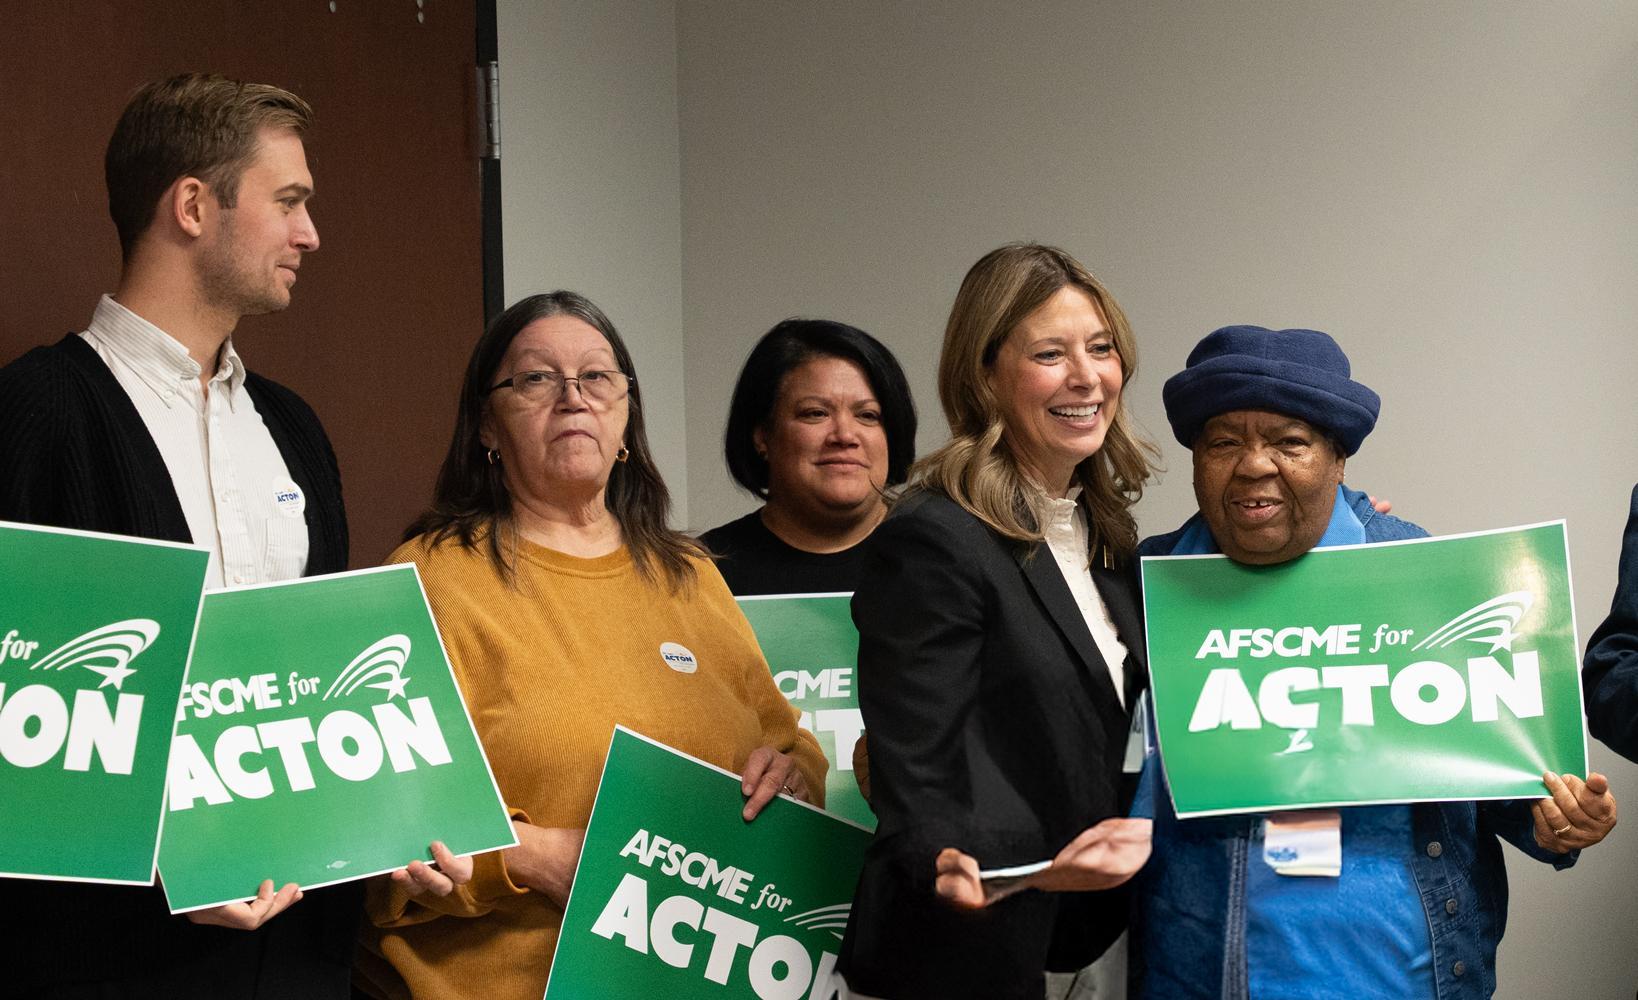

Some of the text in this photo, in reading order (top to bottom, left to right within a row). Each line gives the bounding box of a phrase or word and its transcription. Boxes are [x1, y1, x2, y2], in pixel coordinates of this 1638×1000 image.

[277, 491, 299, 503] ACTON
[0, 629, 39, 665] for
[665, 654, 693, 663] ACTON
[1194, 623, 1414, 660] AFSCME for
[176, 671, 321, 722] FSCME for
[773, 667, 853, 700] CME
[1187, 650, 1544, 733] ACTON
[0, 682, 145, 775] ON
[168, 696, 453, 812] ACTON
[619, 828, 793, 914] AFSCME for
